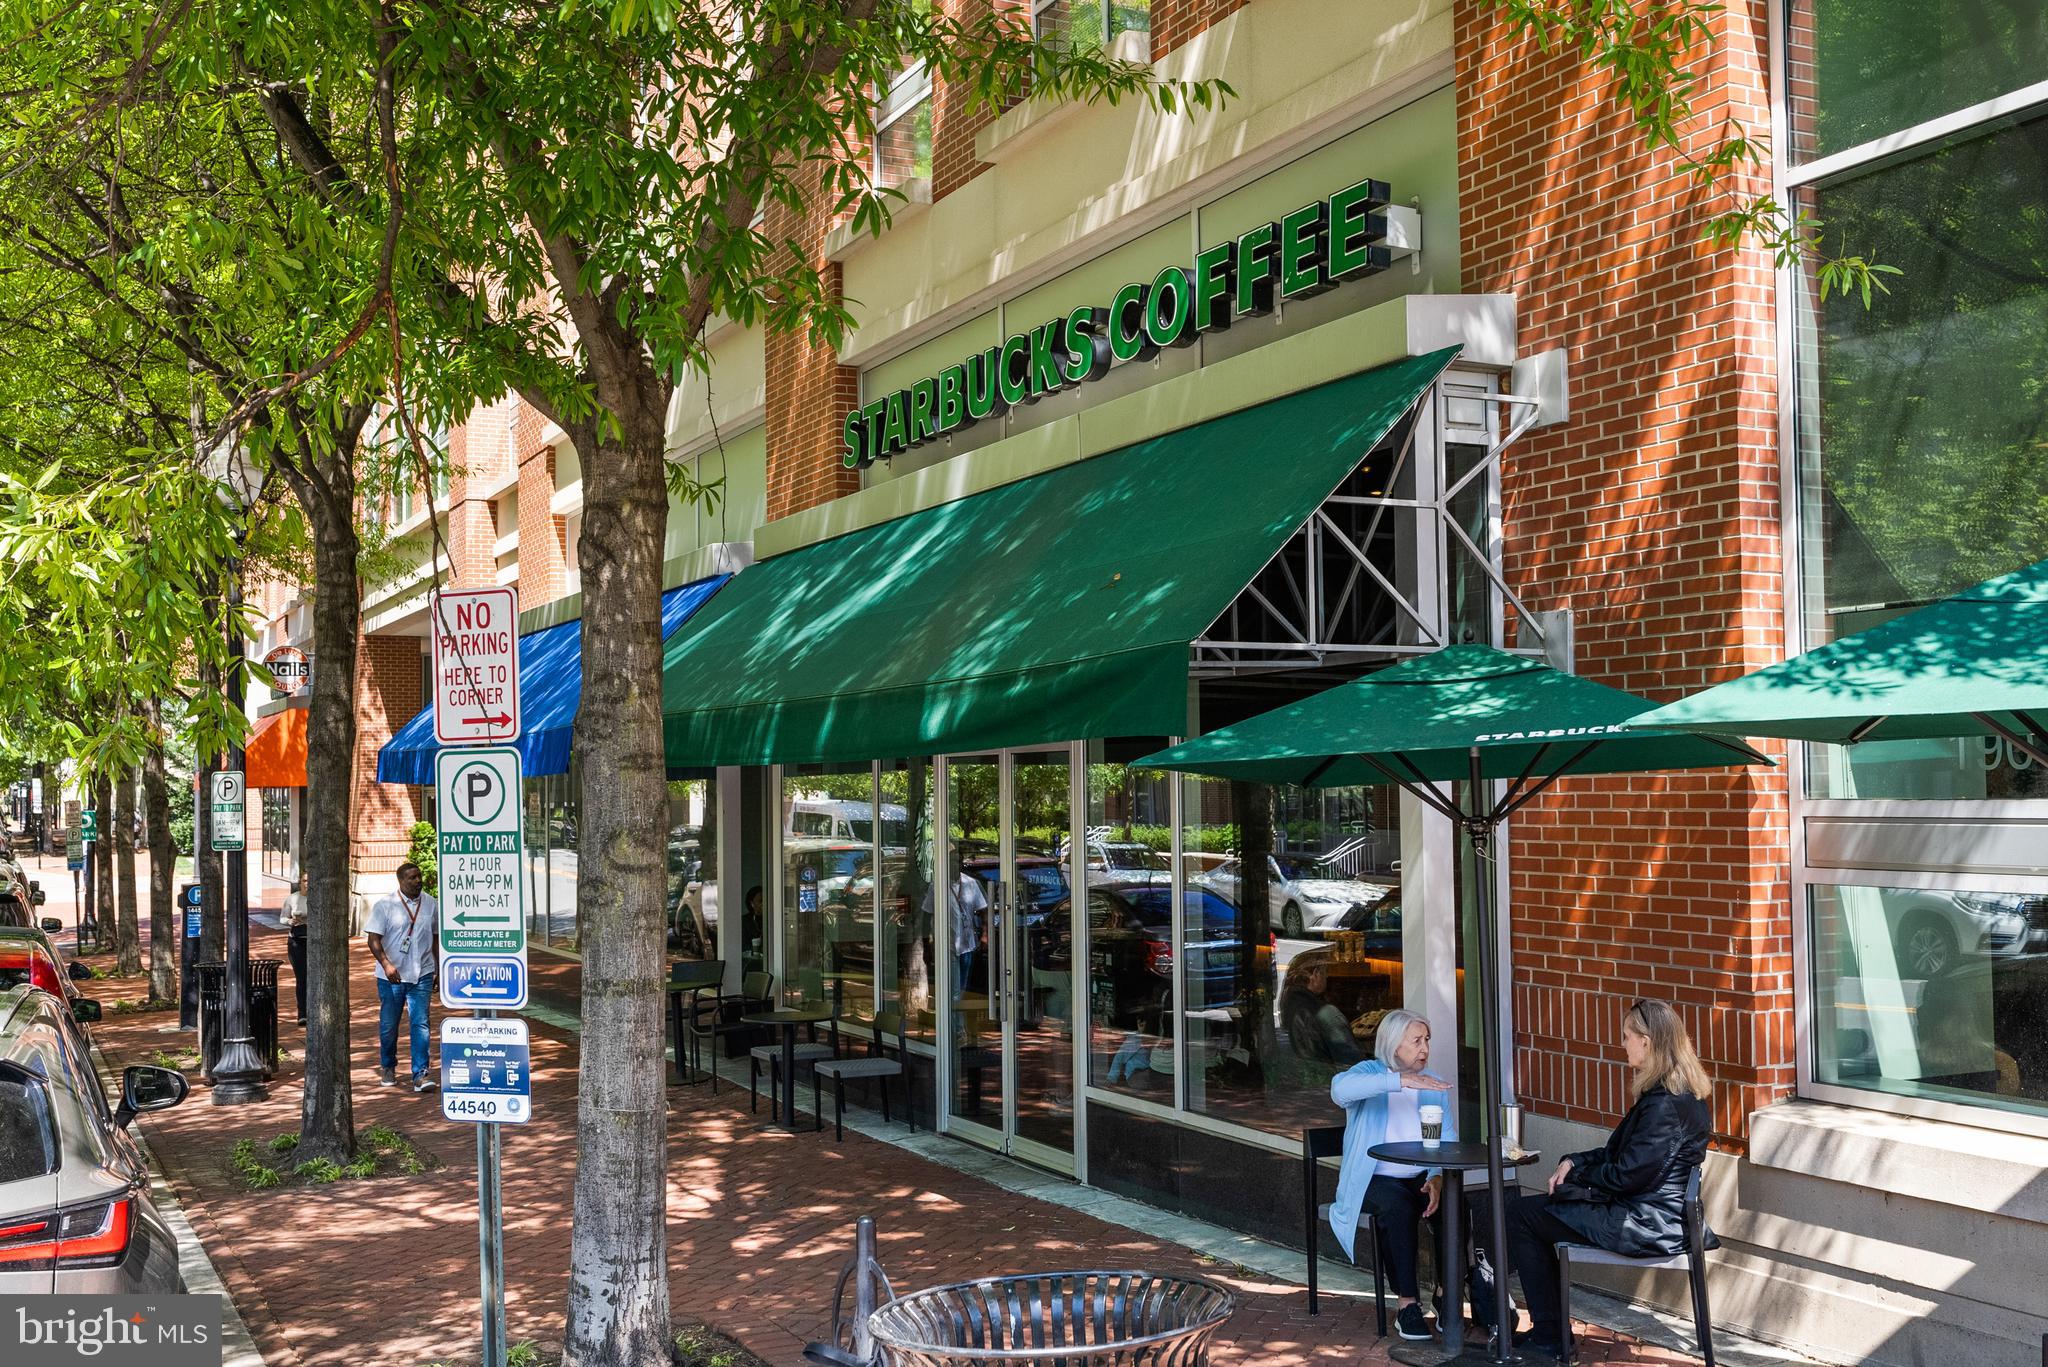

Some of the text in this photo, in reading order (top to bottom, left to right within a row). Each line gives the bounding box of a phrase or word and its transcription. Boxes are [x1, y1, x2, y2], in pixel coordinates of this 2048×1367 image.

[843, 177, 1380, 469] STARBUCKS COFFEE
[456, 602, 491, 631] NO
[441, 631, 509, 658] PARKING
[266, 662, 308, 676] Nails
[444, 665, 507, 687] HERE TO
[449, 687, 503, 706] CORNER
[1474, 724, 1630, 742] STARBUCK
[223, 780, 233, 798] P
[467, 772, 492, 817] P
[443, 835, 516, 852] PAY TO PARK
[458, 857, 501, 872] 2 HOUR
[448, 874, 513, 890] 8AM-9PM
[455, 894, 510, 908] MON-SAT
[453, 930, 481, 938] LICENSE
[482, 930, 503, 938] PLATE
[448, 940, 517, 948] REQUIRED AT METER
[453, 966, 512, 981] PAY STATION
[450, 1026, 517, 1036] PAY FOR PARKING
[472, 1049, 506, 1057] ParkMobile
[447, 1100, 497, 1115] 44540
